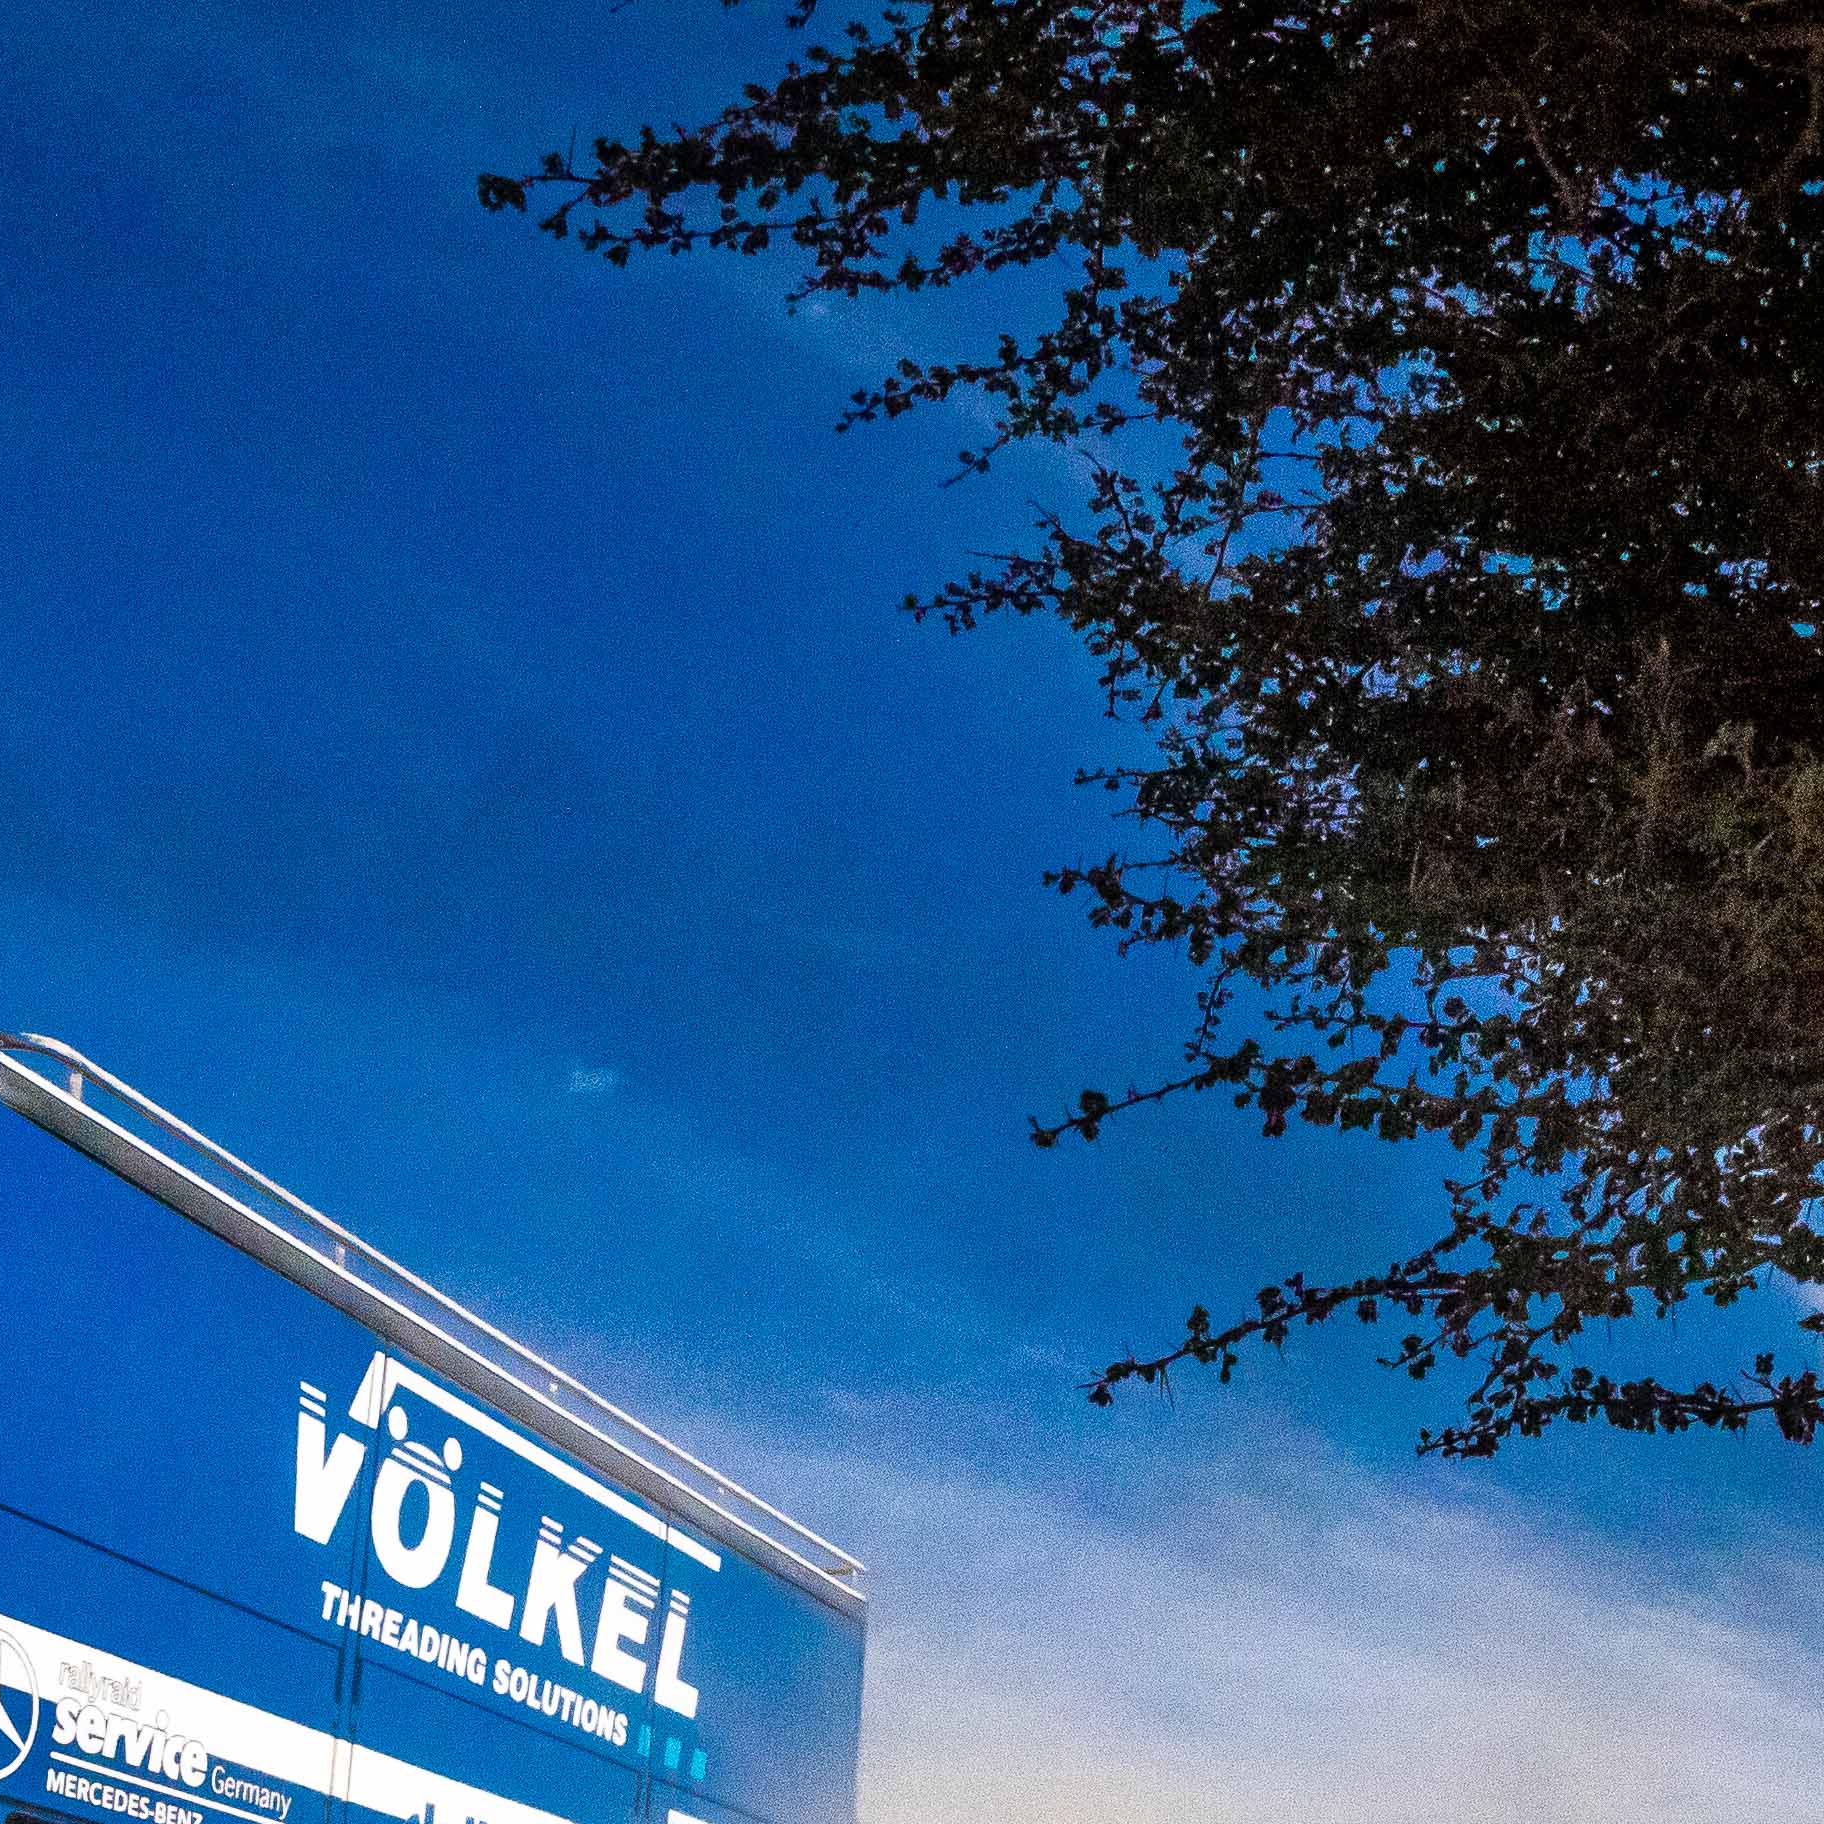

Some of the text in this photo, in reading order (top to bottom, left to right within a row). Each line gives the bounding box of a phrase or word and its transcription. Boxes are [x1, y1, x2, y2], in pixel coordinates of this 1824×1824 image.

[294, 1381, 700, 1719] VÖLKEL
[321, 1581, 628, 1746] THREADING SOLUTIONS
[52, 1697, 292, 1820] service Germany
